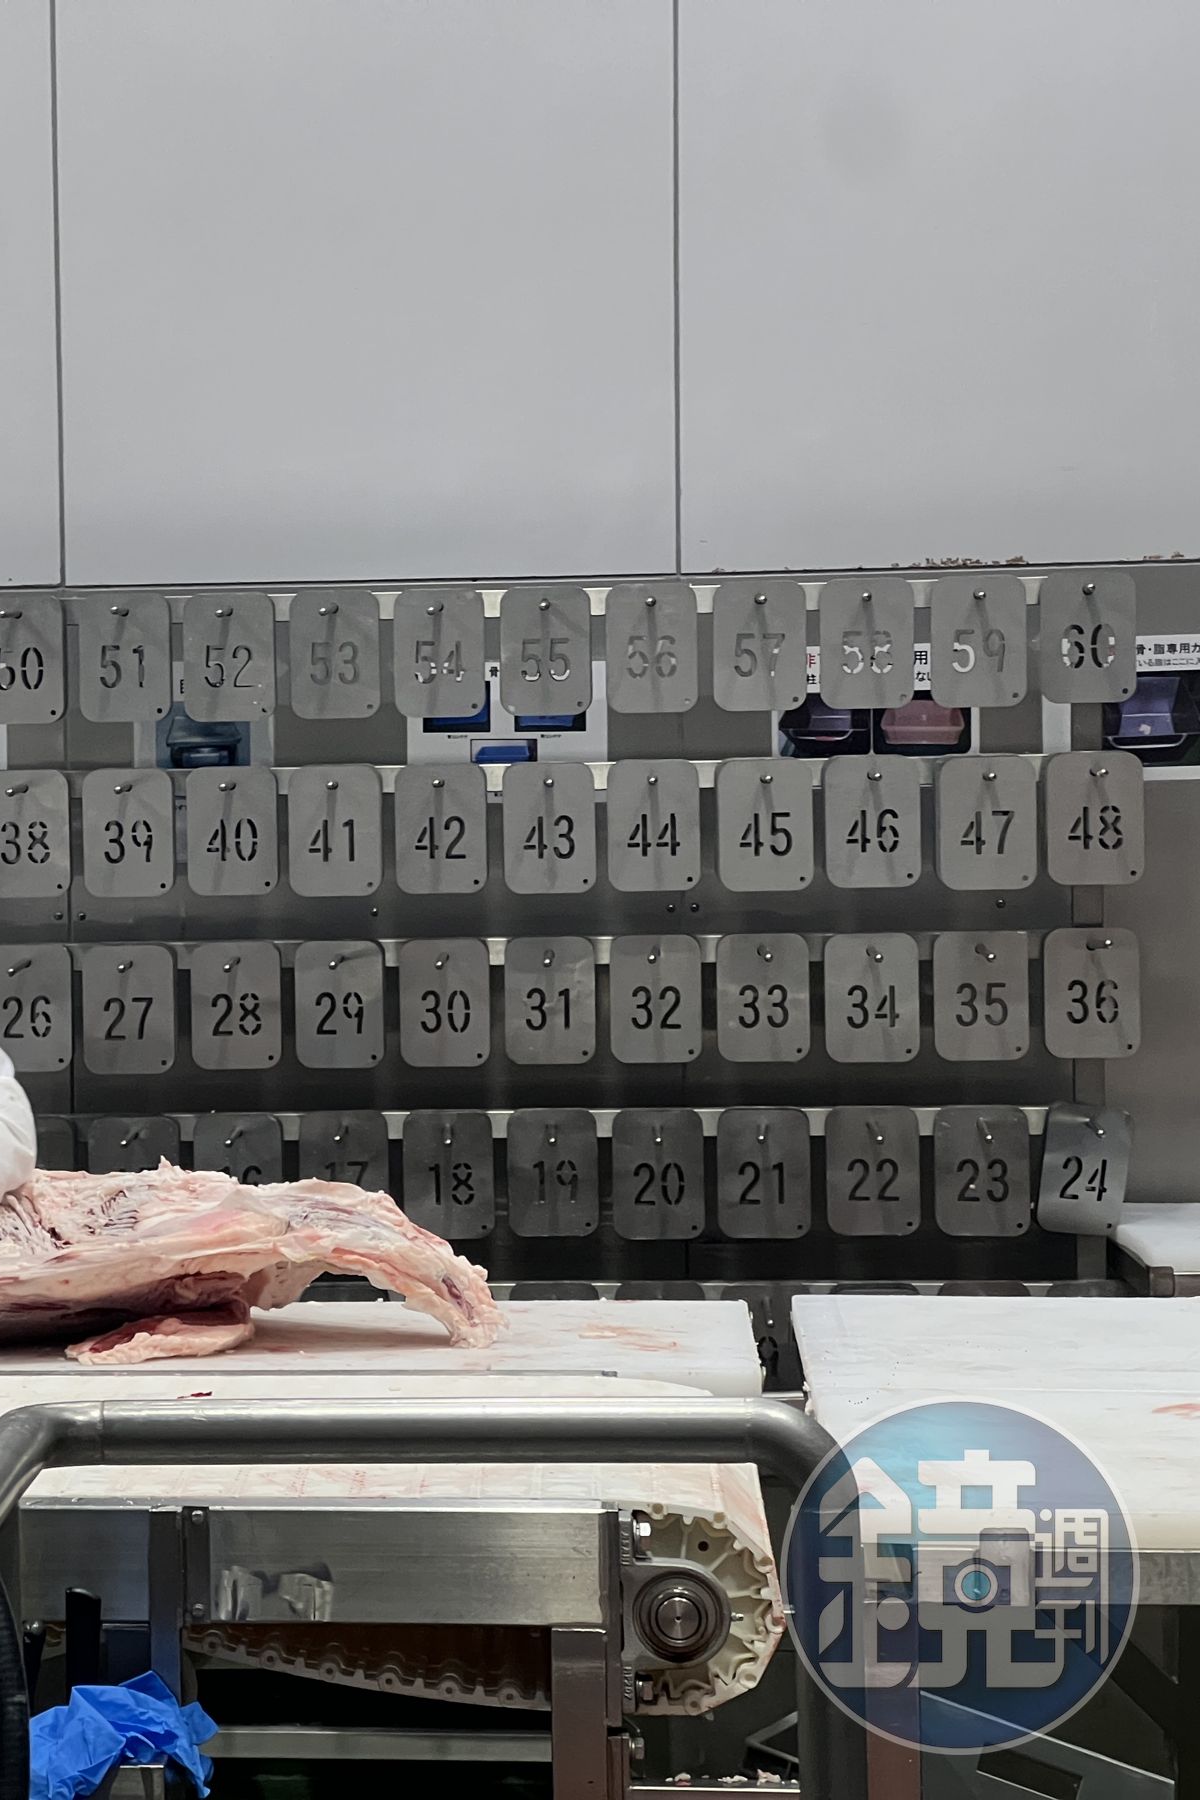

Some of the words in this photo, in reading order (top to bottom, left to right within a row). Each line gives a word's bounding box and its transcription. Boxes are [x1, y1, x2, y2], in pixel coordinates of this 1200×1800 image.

[100, 645, 145, 688] 51
[204, 645, 254, 688] 52
[310, 641, 359, 685] 53
[414, 640, 464, 684] 54
[521, 638, 570, 682] 55
[627, 634, 676, 679] 56
[733, 633, 785, 678] 57
[842, 630, 893, 675] 58
[952, 629, 1006, 674] 59
[1061, 624, 1116, 670] 60
[1, 820, 50, 864] 38
[104, 820, 153, 864] 39
[207, 818, 258, 862] 40
[308, 819, 355, 863] 41
[415, 816, 466, 860] 42
[523, 815, 575, 860] 43
[627, 813, 680, 857] 44
[740, 812, 792, 856] 45
[846, 809, 900, 853] 46
[961, 810, 1014, 854] 47
[1068, 805, 1123, 850] 48
[3, 996, 52, 1039] 26
[104, 997, 154, 1041] 27
[211, 993, 262, 1037] 28
[315, 991, 364, 1036] 29
[420, 990, 471, 1033] 30
[525, 988, 571, 1031] 31
[631, 986, 682, 1030] 32
[738, 984, 789, 1029] 33
[846, 984, 900, 1029] 34
[956, 982, 1008, 1027] 35
[1066, 979, 1119, 1024] 36
[428, 1163, 475, 1205] 18
[533, 1160, 579, 1203] 19
[633, 1162, 685, 1206] 20
[738, 1161, 785, 1205] 21
[847, 1158, 900, 1202] 22
[956, 1158, 1010, 1202] 23
[1059, 1156, 1107, 1202] 24
